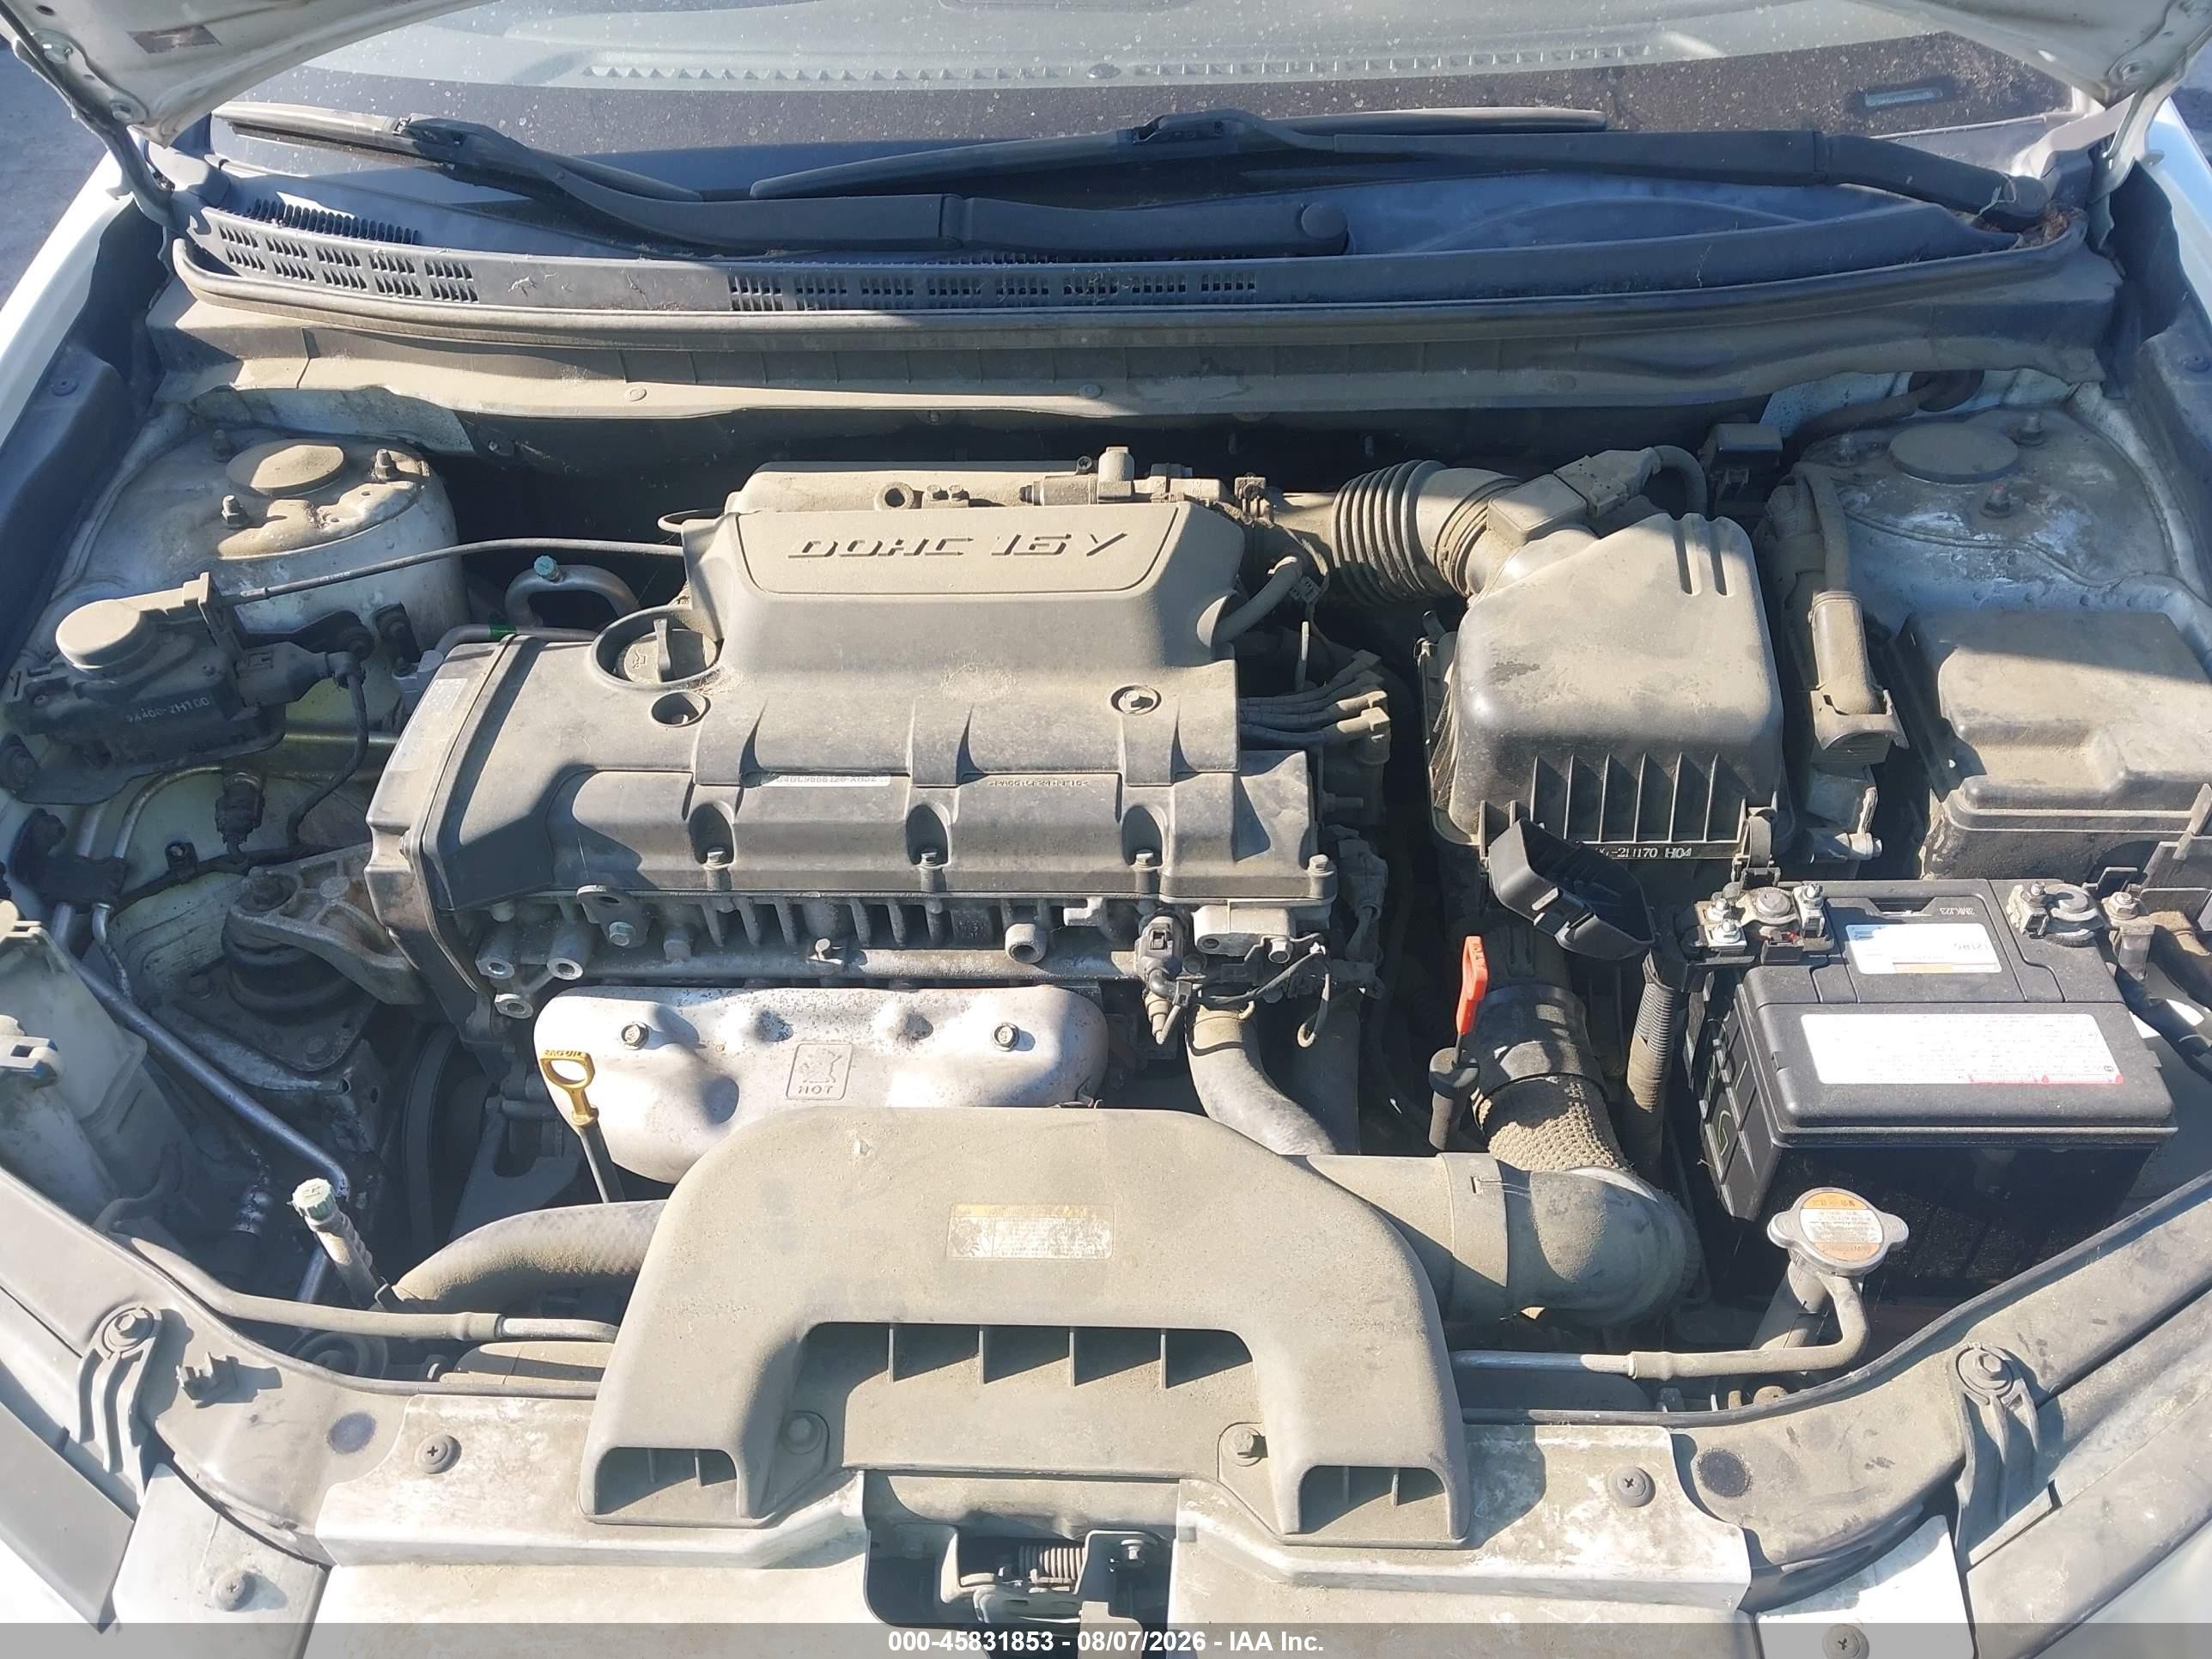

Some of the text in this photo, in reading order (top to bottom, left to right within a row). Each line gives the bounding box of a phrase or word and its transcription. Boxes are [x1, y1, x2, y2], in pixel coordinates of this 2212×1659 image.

[787, 538, 974, 559] DOHC
[1664, 847, 1692, 859] H04
[798, 1085, 834, 1095] HOT
